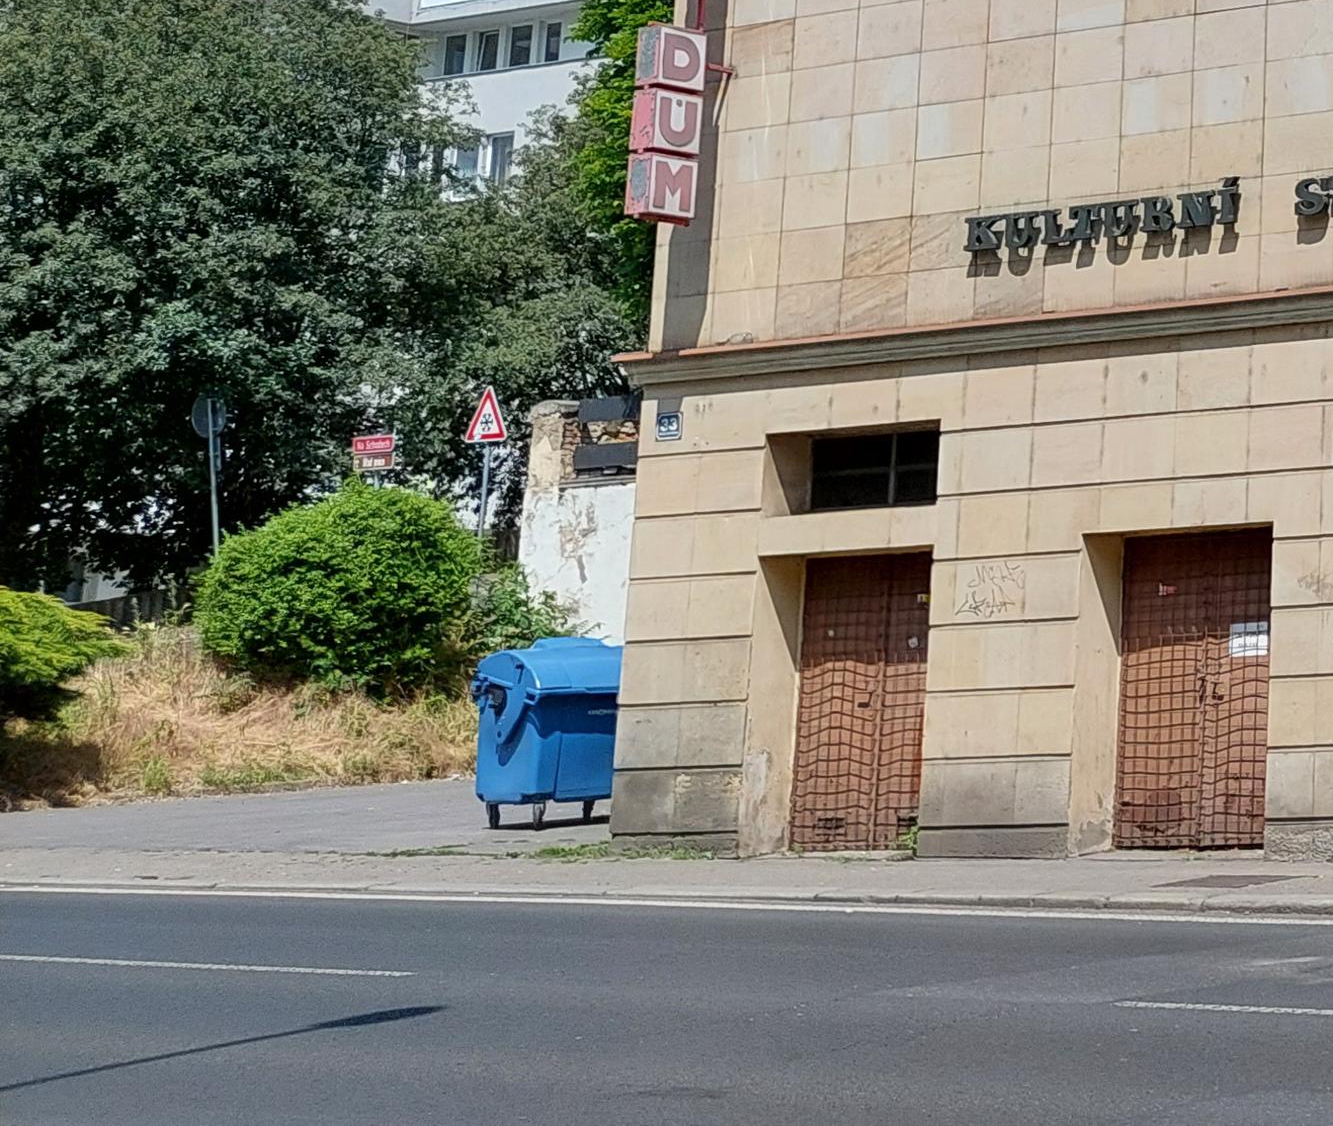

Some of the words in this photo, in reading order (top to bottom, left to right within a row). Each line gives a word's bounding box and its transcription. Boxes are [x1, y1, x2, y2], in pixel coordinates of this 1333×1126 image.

[652, 32, 701, 214] DŮM
[963, 176, 1241, 252] KULTURNÍ
[660, 417, 678, 432] 33
